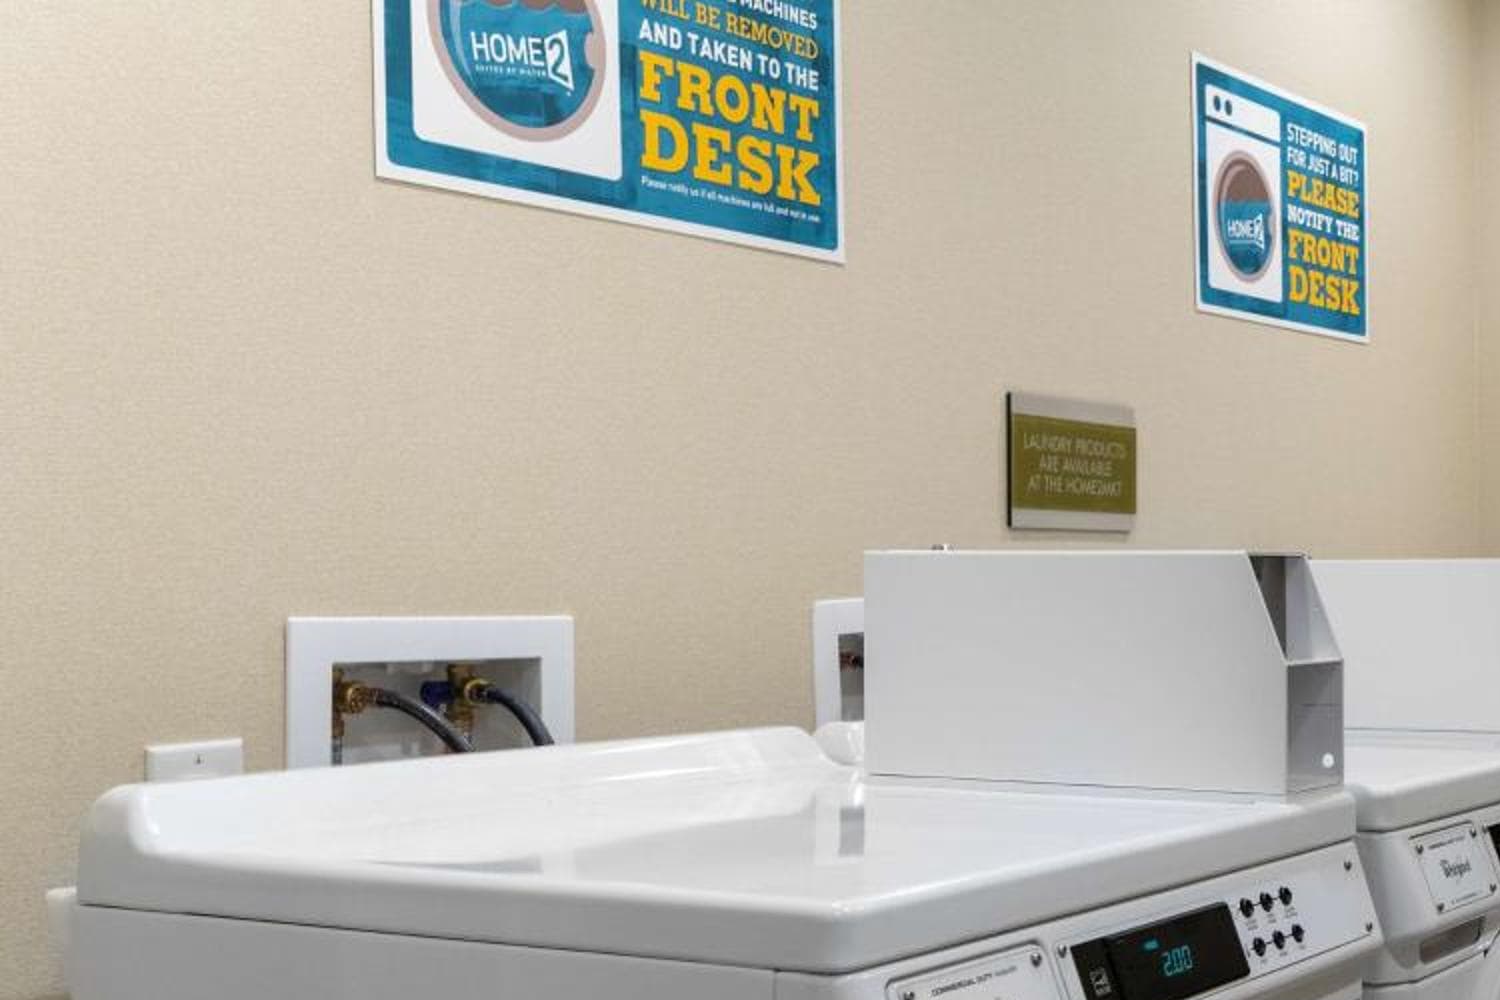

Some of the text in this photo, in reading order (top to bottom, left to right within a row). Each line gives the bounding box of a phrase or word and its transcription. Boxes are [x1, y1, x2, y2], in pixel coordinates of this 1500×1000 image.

[639, 18, 820, 91] AND TAKEN TO THE
[696, 2, 721, 31] BE
[725, 12, 818, 60] REMOVED
[639, 50, 819, 143] FRONT
[639, 108, 821, 207] DESK
[1286, 122, 1358, 166] STEPPING OUT
[1287, 145, 1359, 187] FOR JUST A BIT?
[1287, 169, 1360, 219] PLEASE
[1287, 203, 1359, 243] NOTIFY THE
[1287, 228, 1359, 275] FRONT
[1288, 264, 1360, 316] DESK
